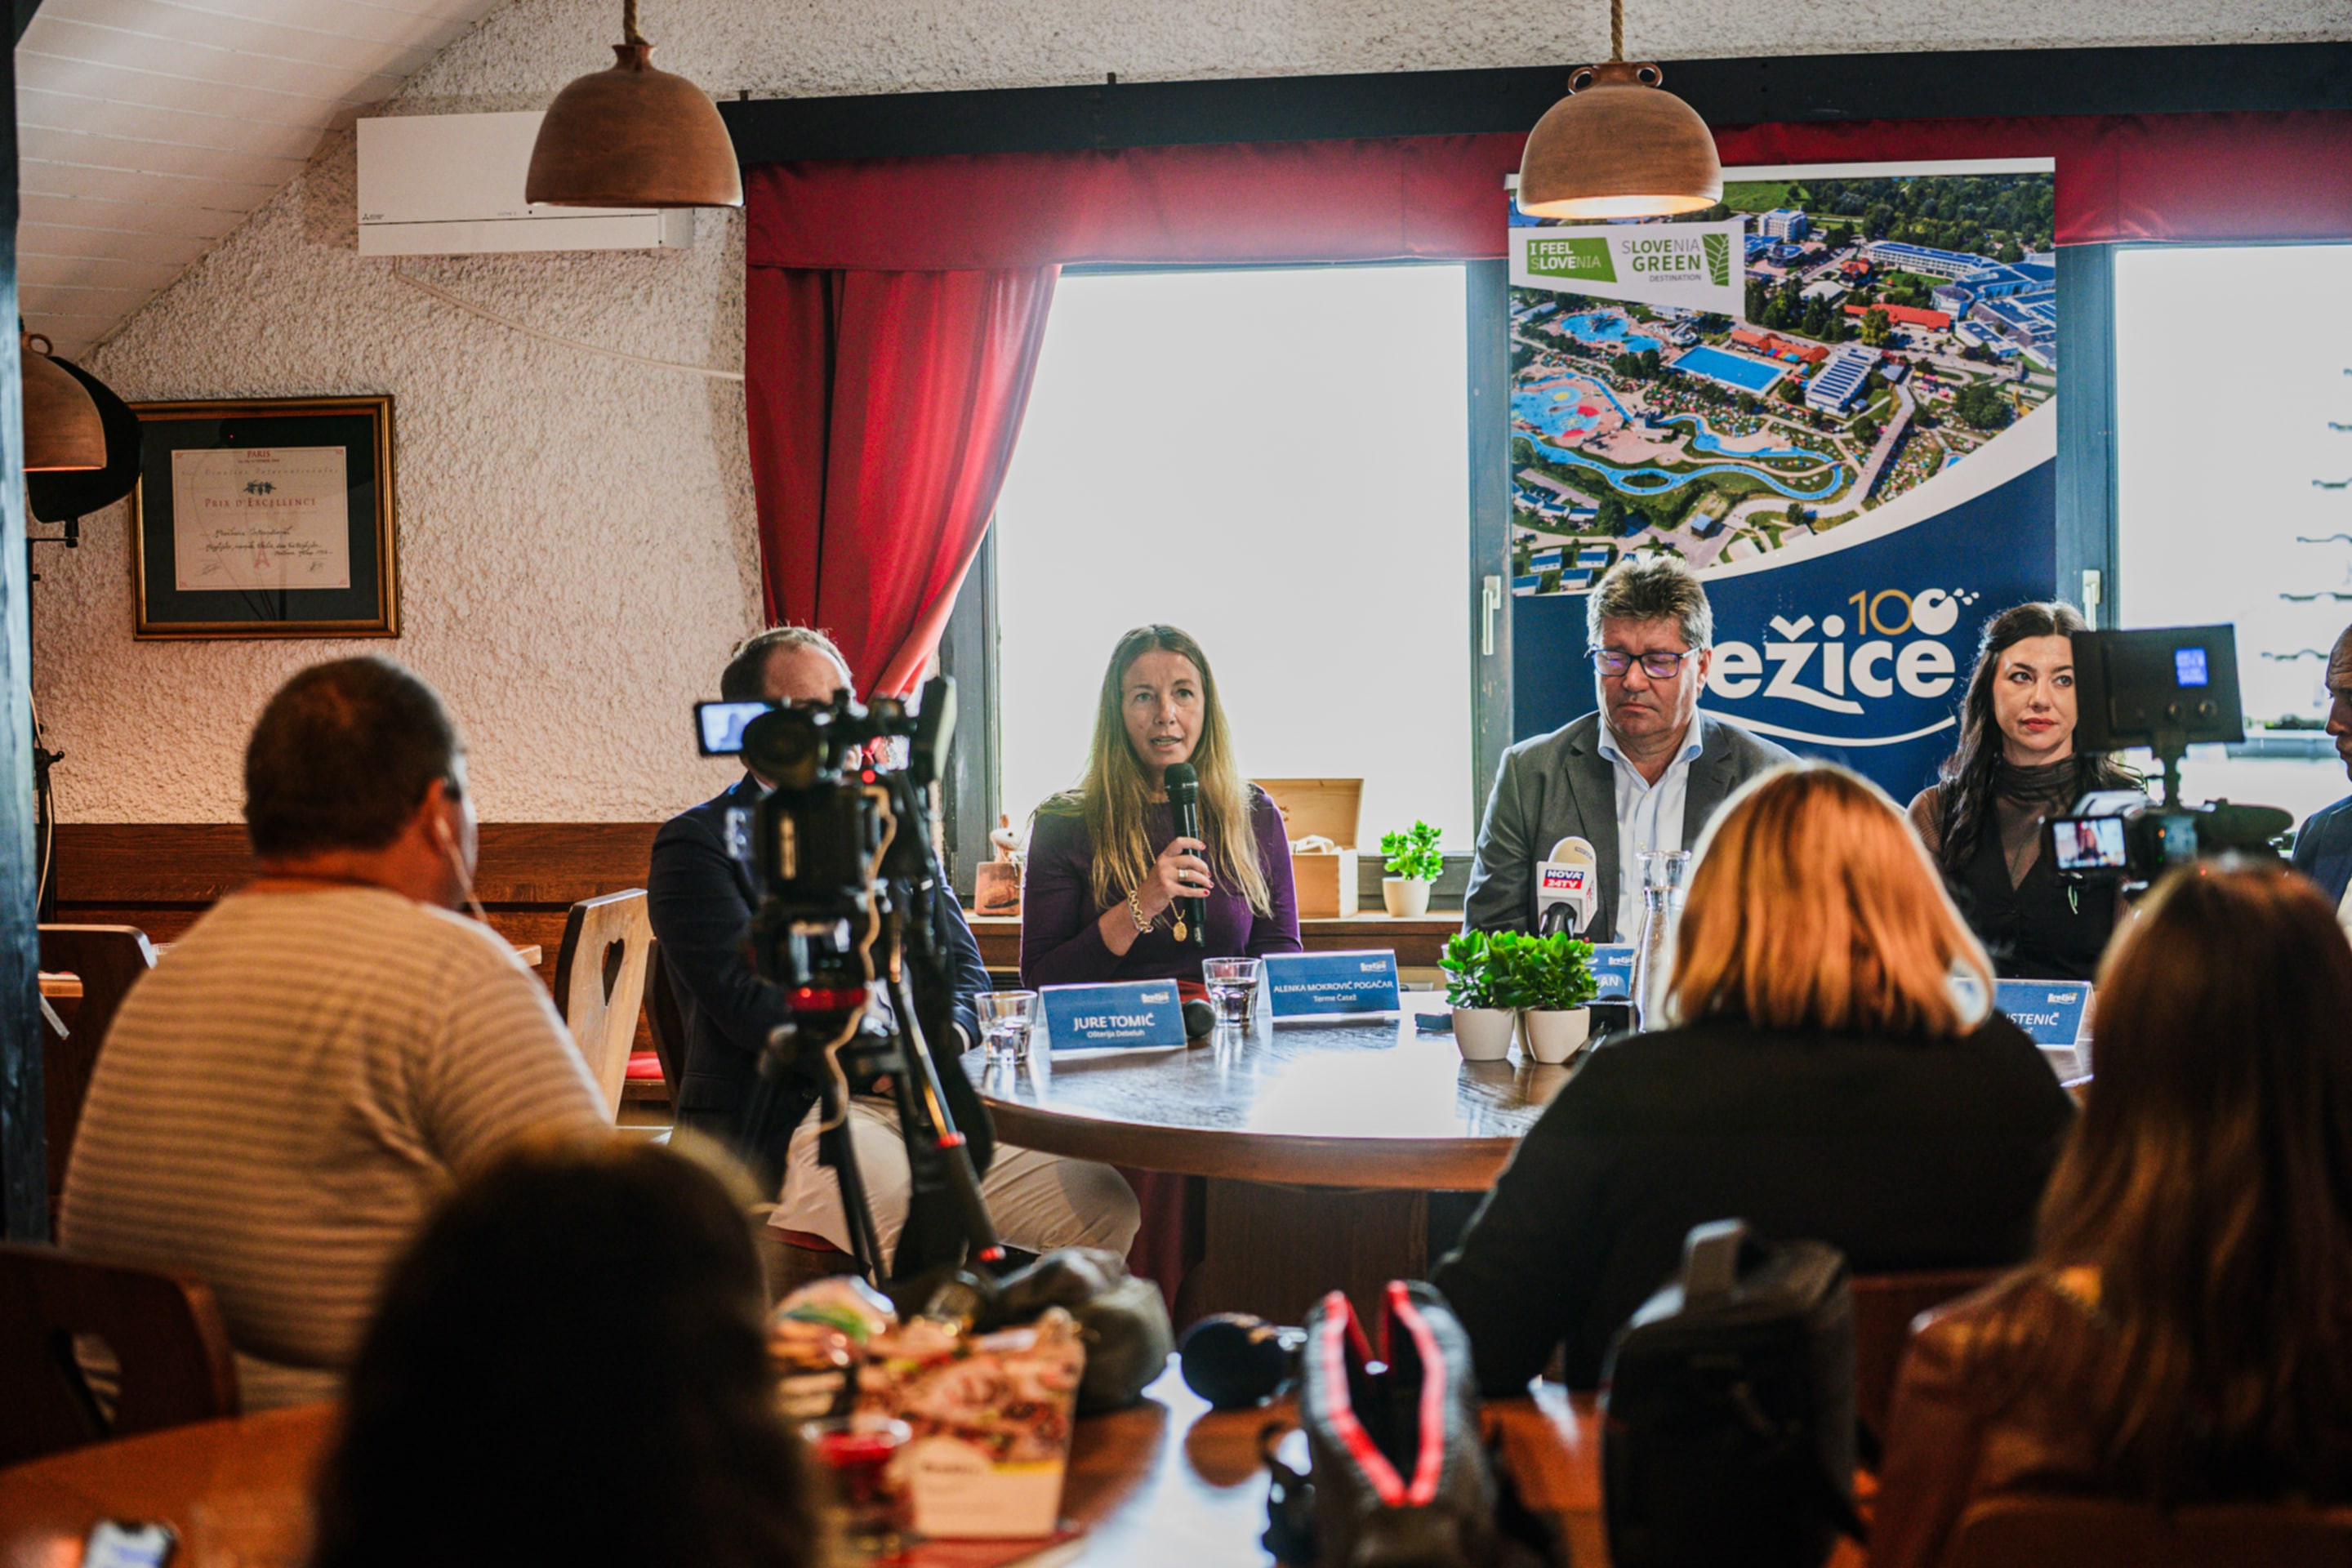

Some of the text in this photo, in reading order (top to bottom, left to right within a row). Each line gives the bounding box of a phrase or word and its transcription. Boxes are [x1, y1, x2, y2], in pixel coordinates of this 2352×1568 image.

[1530, 242, 1574, 256] I FEEL
[1621, 238, 1701, 255] SLOVENIA
[1530, 255, 1602, 270] SLOVENIA
[1632, 254, 1701, 272] GREEN
[1649, 274, 1702, 283] DESTINATION
[247, 450, 271, 458] PARIS
[1547, 870, 1583, 880] NOVA
[1547, 880, 1579, 888] 24TV
[1273, 983, 1307, 994] ALENKA
[1354, 979, 1394, 990] POGAČAR
[1312, 995, 1336, 1003] Terme
[1073, 1015, 1107, 1031] JURE
